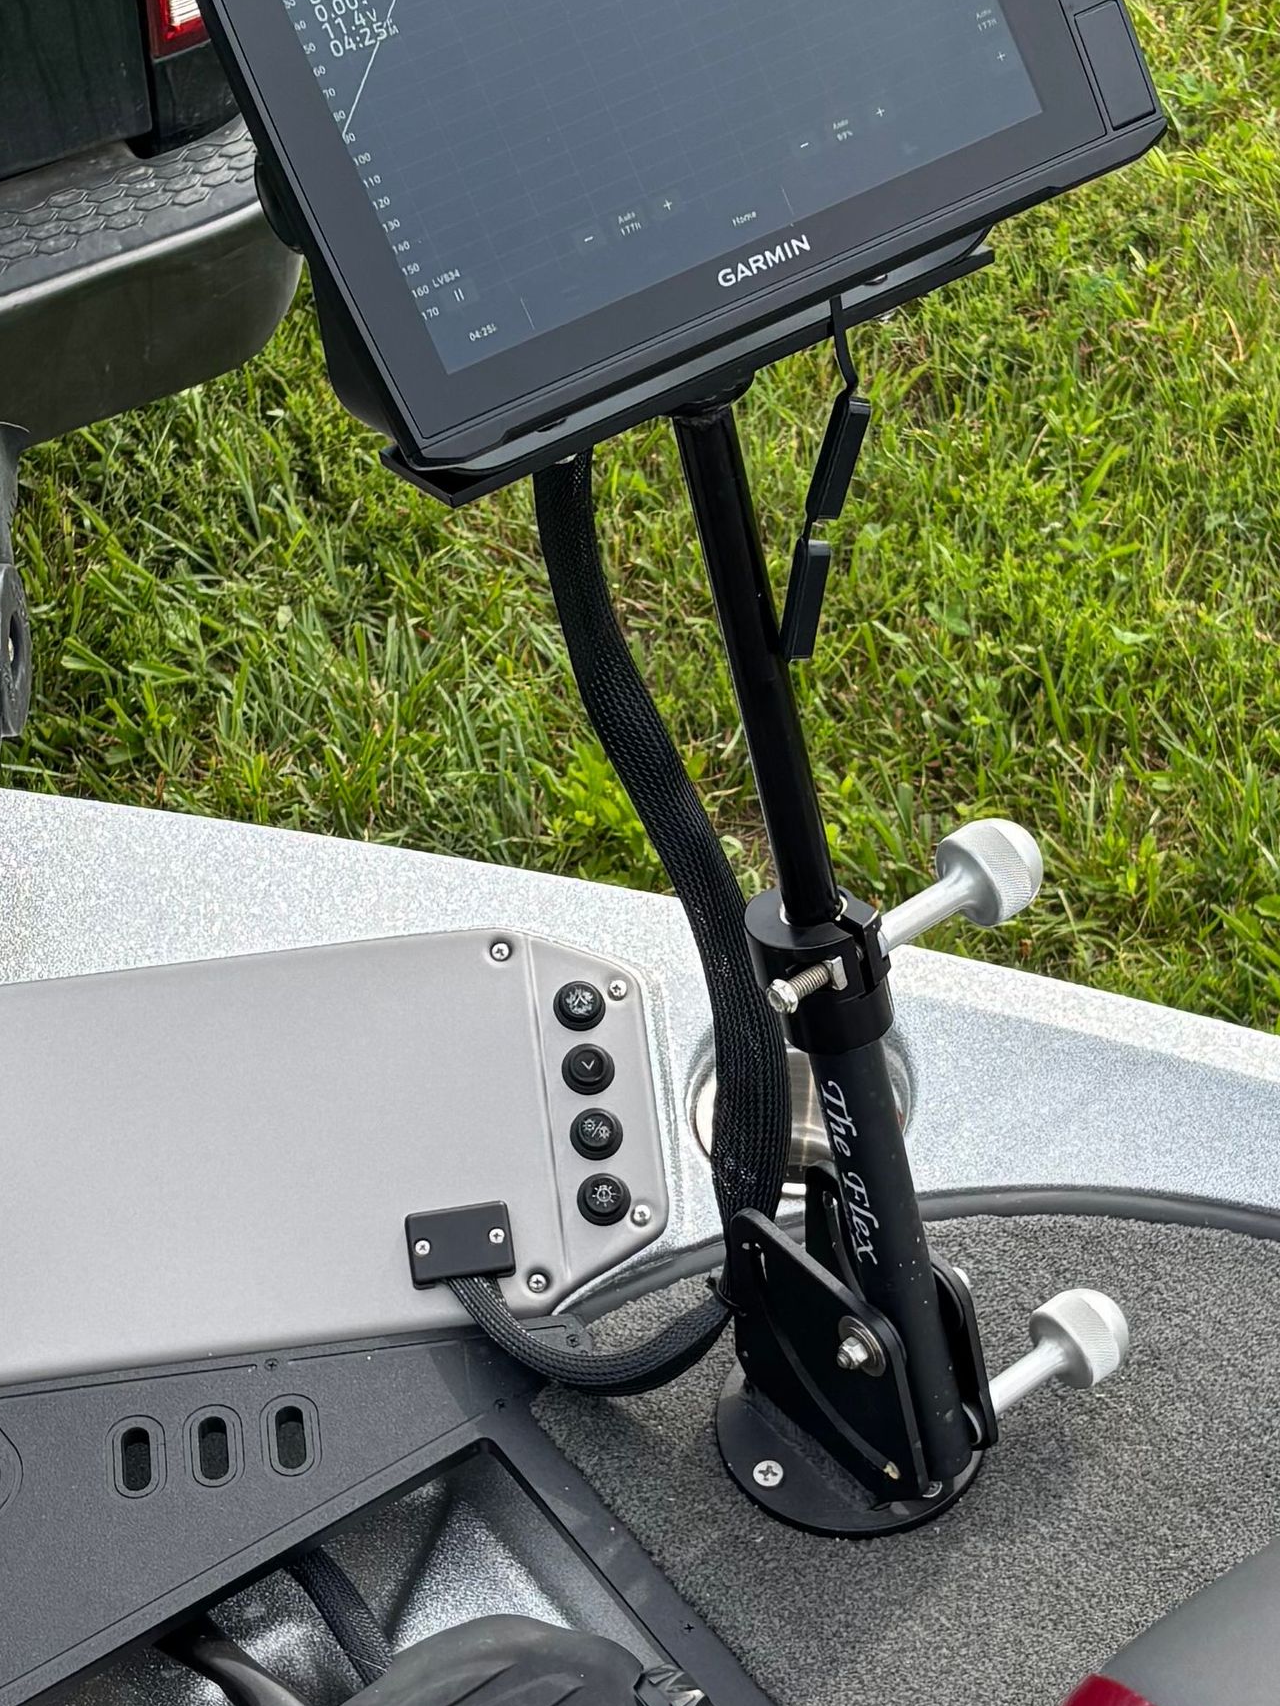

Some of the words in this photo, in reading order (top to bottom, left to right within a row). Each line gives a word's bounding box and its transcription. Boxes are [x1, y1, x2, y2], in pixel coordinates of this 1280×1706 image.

[353, 152, 371, 167] 100
[363, 175, 381, 188] 110
[372, 197, 390, 210] 120
[732, 210, 757, 227] Home
[382, 219, 400, 233] 130
[717, 234, 811, 287] GARMIN
[402, 263, 420, 277] 150
[411, 285, 430, 299] 160
[421, 306, 440, 321] 170
[821, 1080, 857, 1157] The
[842, 1171, 879, 1265] Flex
